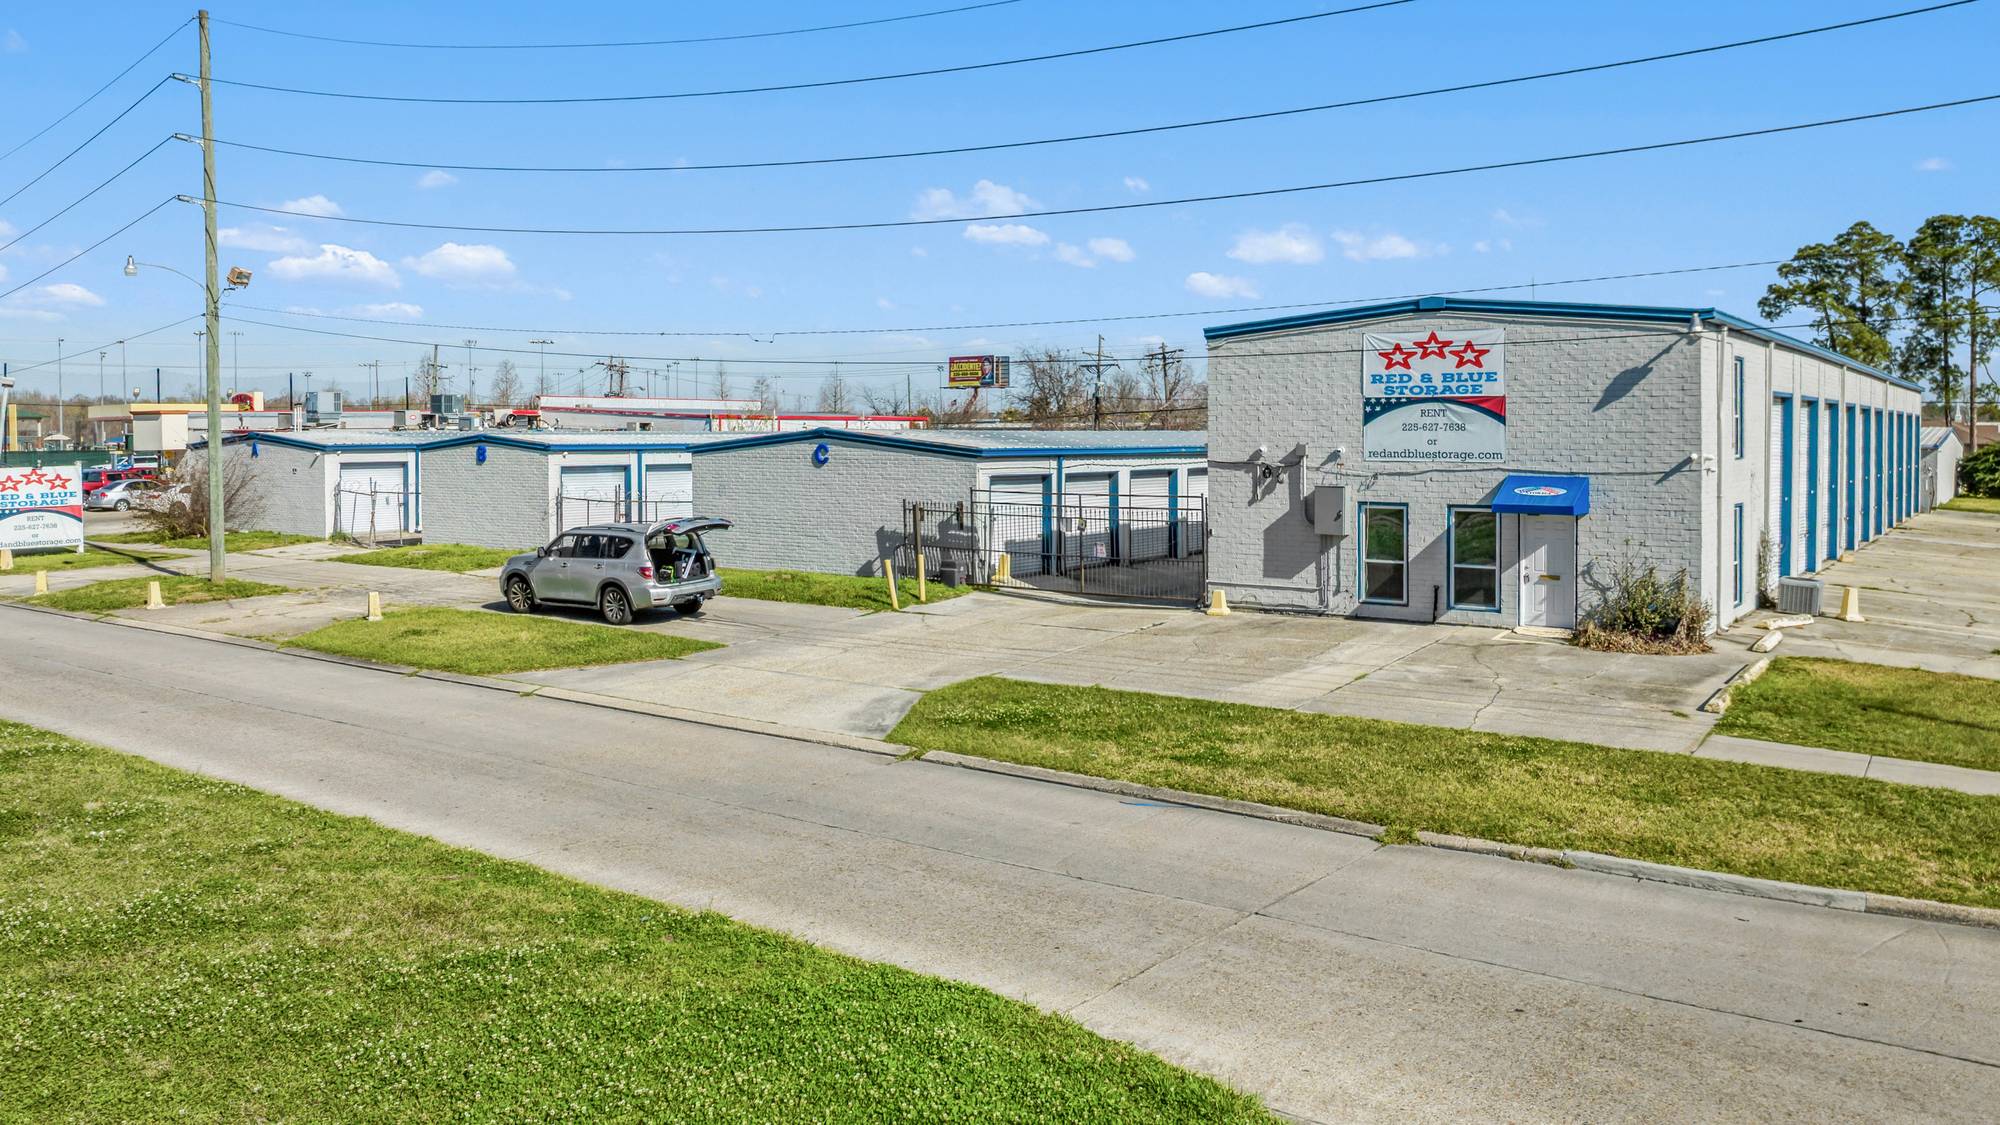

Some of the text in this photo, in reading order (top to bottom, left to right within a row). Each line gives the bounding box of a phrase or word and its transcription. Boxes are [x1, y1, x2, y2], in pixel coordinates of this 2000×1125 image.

[1370, 372, 1497, 384] RED & BLUE
[1383, 385, 1482, 396] STORAGE
[1420, 409, 1447, 417] RENT
[1401, 423, 1466, 431] 225-627-7638
[815, 442, 830, 465] C
[1368, 449, 1503, 461] redandbluestorage.com
[40, 491, 77, 499] BLUE
[0, 499, 68, 507] STORAGE
